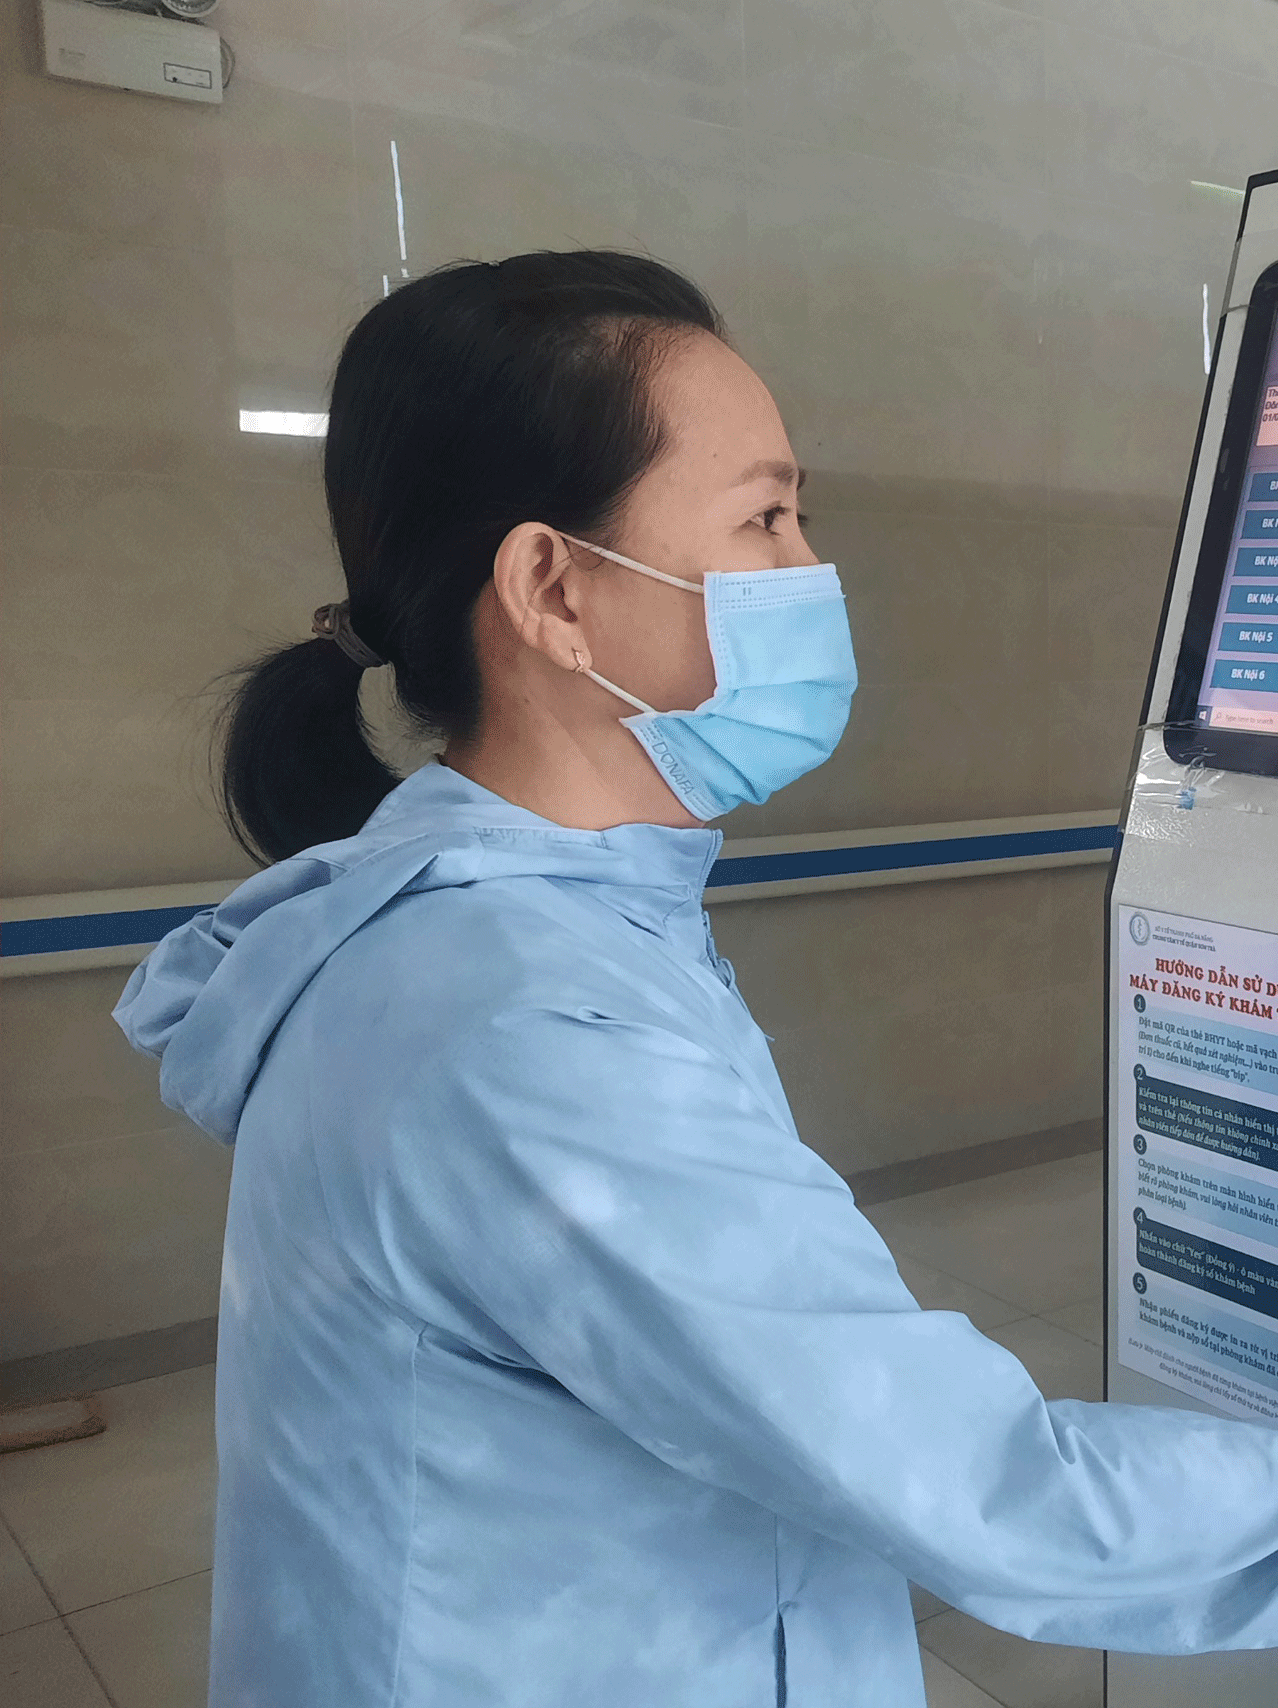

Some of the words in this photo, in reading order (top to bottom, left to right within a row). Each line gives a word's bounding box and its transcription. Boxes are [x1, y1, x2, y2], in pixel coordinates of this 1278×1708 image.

[652, 741, 694, 795] DONAFA
[1130, 973, 1158, 992] MÁY
[1162, 980, 1201, 1002] ĐĂNG
[1205, 990, 1226, 1008] KÝ
[1230, 996, 1272, 1020] KHÁM
[1156, 958, 1204, 981] HƯỚNG
[1208, 965, 1238, 989] DẪN
[1242, 974, 1262, 994] SỬ
[1138, 1016, 1151, 1028] Đặt
[1164, 1022, 1176, 1034] QR
[1204, 1032, 1226, 1046] BHYT
[1227, 1038, 1244, 1052] hoặc
[1246, 1044, 1258, 1054] mã
[1259, 1048, 1278, 1060] vạch
